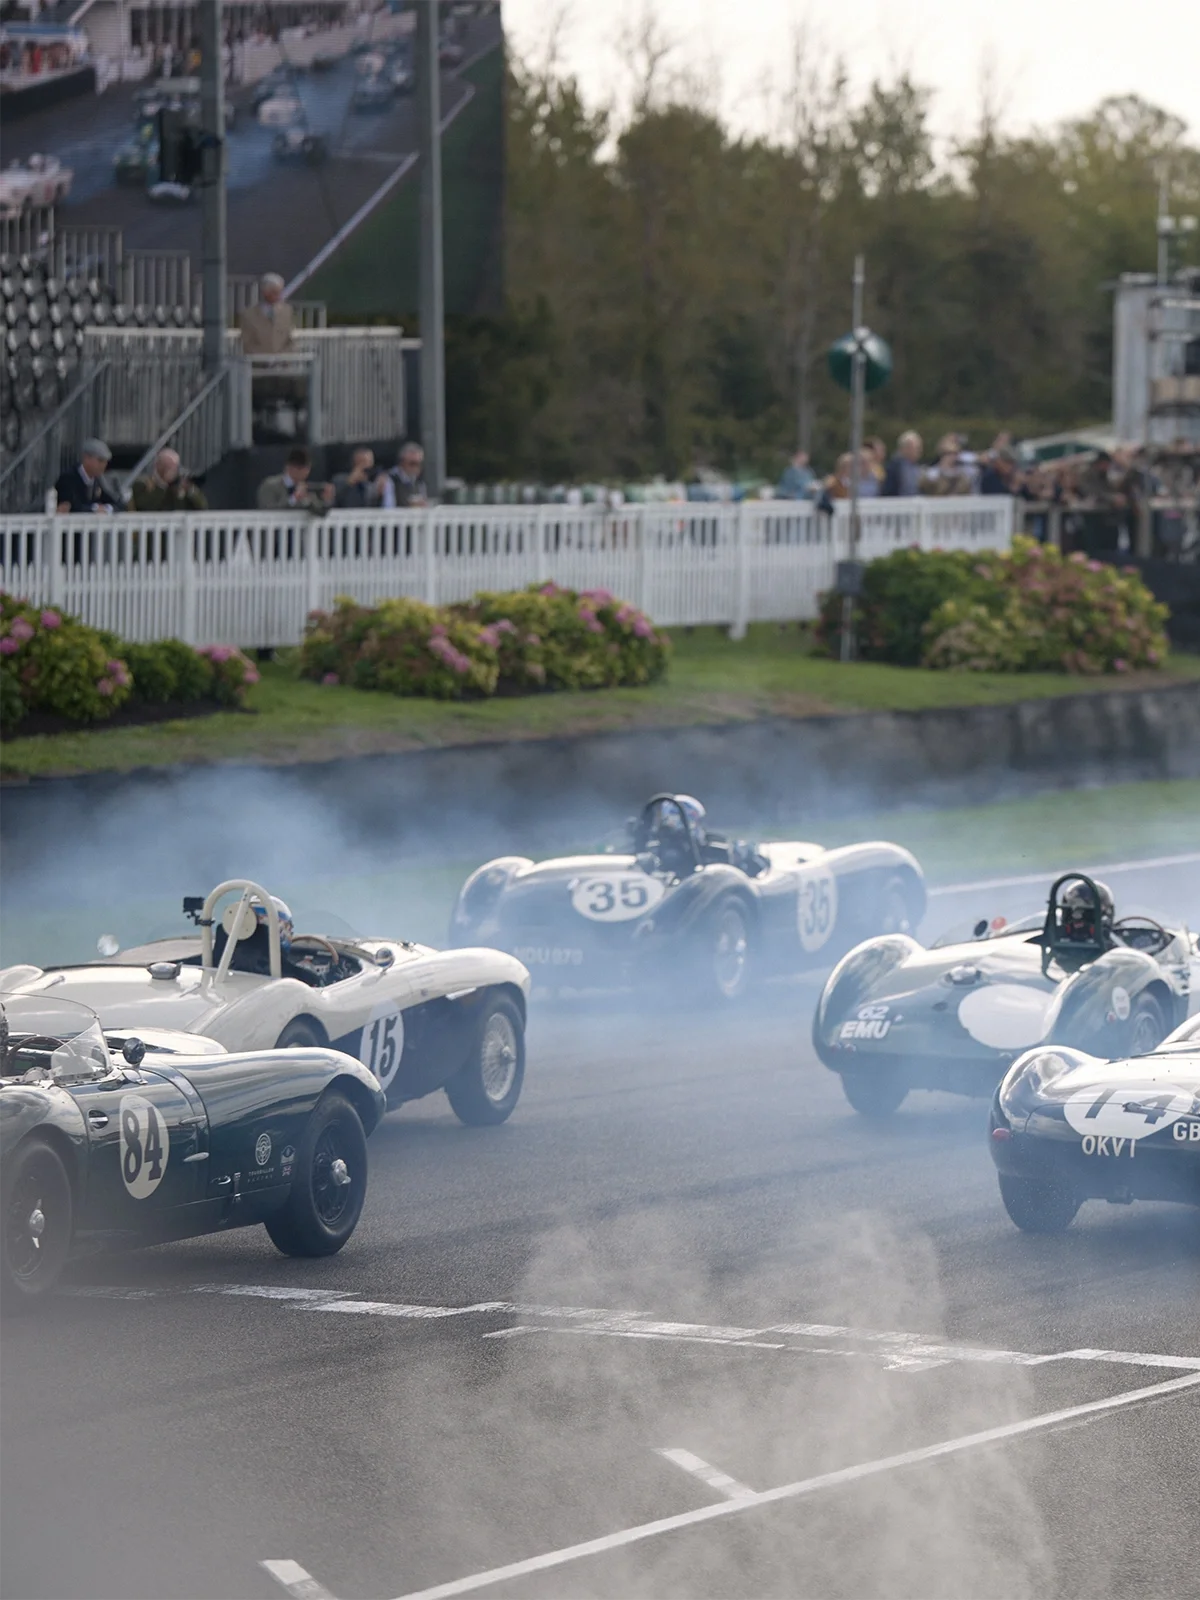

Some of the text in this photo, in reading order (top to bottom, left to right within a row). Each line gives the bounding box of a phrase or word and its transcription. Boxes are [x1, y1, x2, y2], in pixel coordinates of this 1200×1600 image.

[587, 880, 648, 914] 35
[804, 878, 830, 937] 35
[840, 1020, 891, 1039] EMU
[858, 1005, 890, 1020] 62
[370, 1016, 398, 1077] 15
[1085, 1088, 1177, 1125] 14
[122, 1106, 163, 1184] 84
